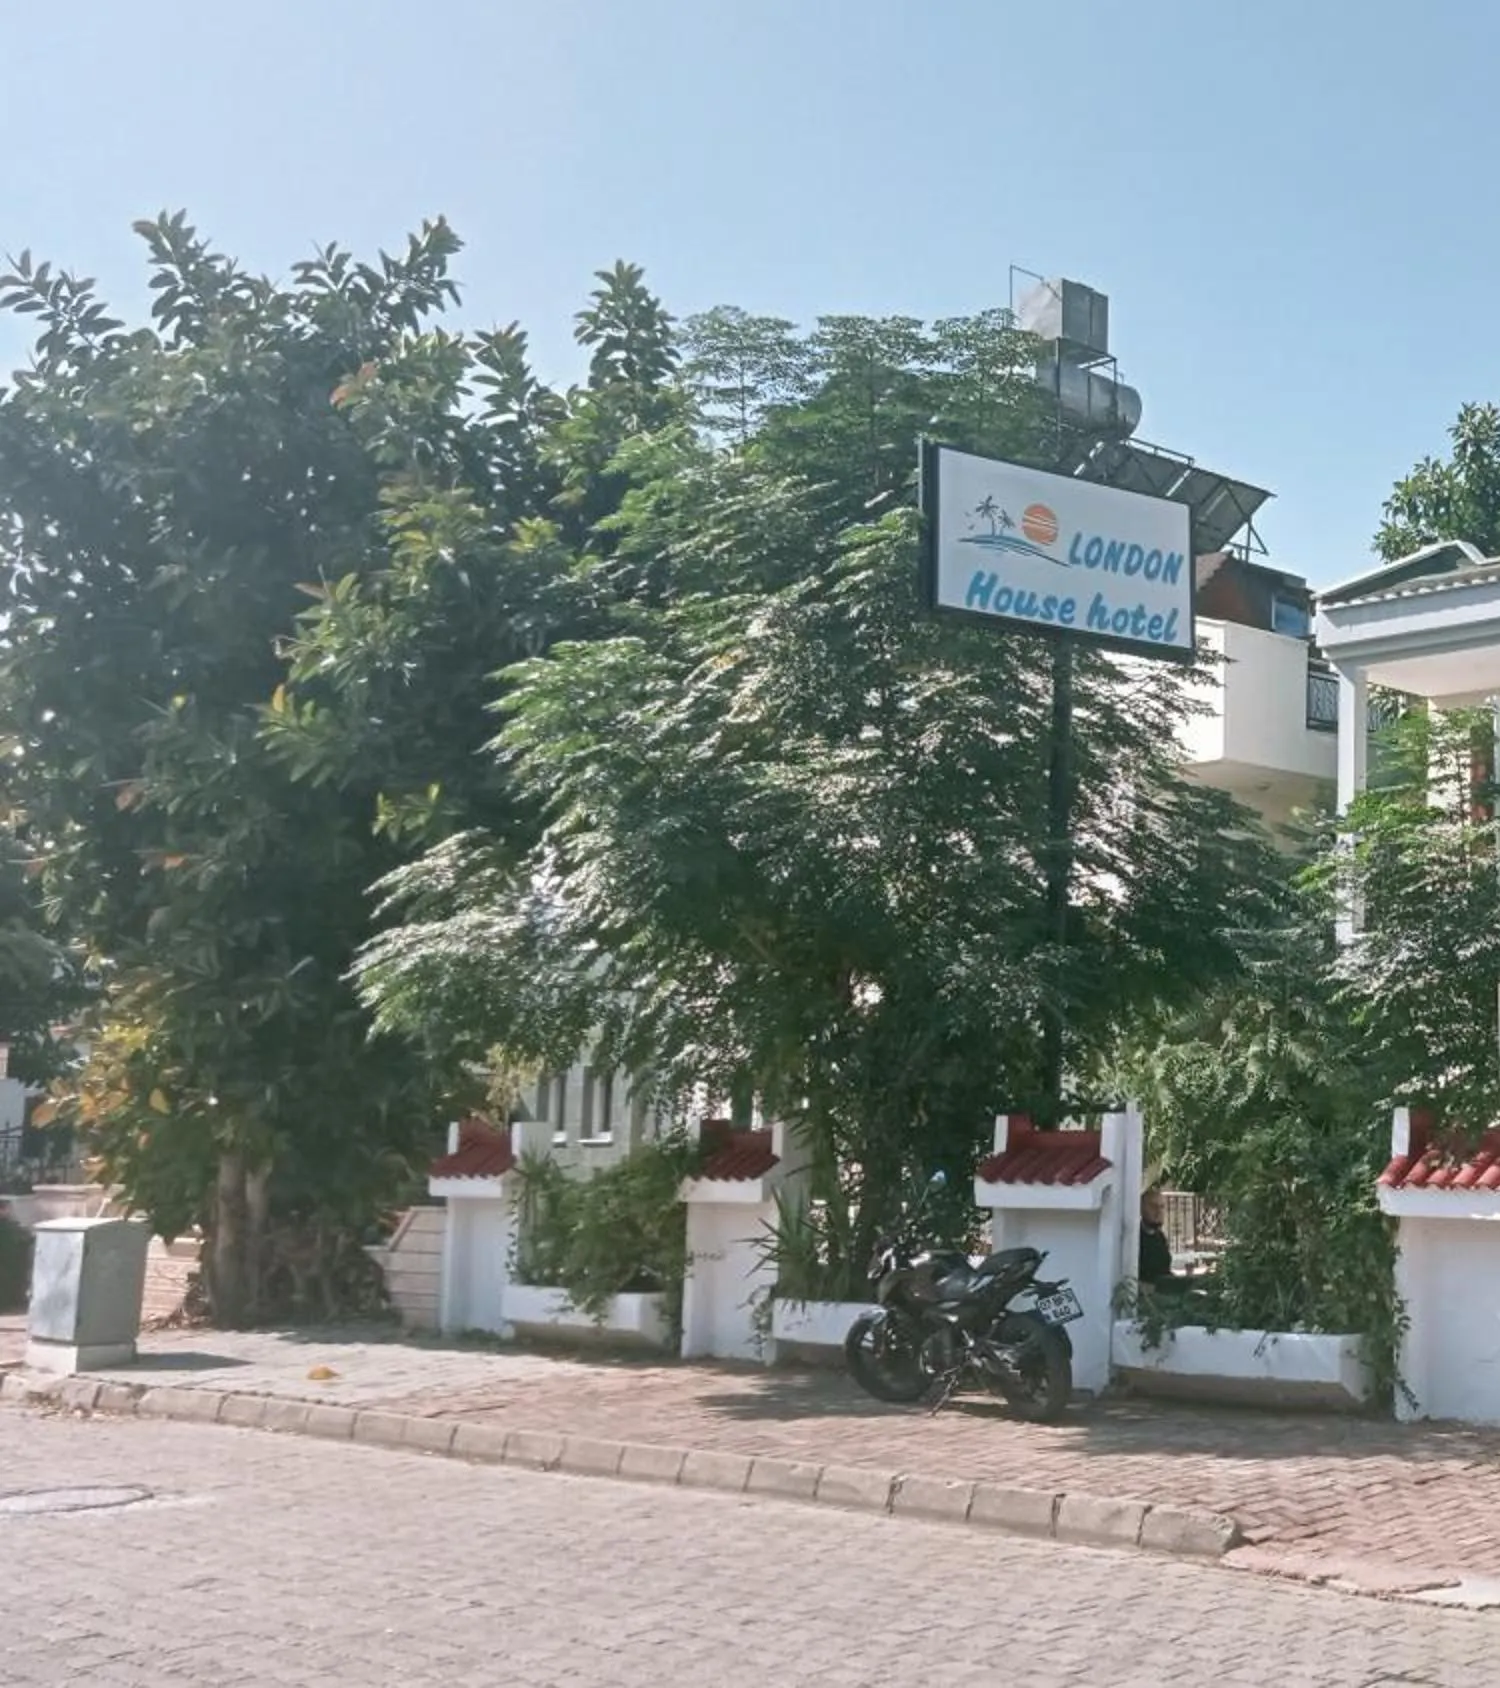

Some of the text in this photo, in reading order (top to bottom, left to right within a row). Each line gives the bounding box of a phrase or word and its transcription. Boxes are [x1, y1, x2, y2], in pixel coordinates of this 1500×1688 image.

[1068, 532, 1184, 585] LONDON
[964, 570, 1180, 642] House hotel
